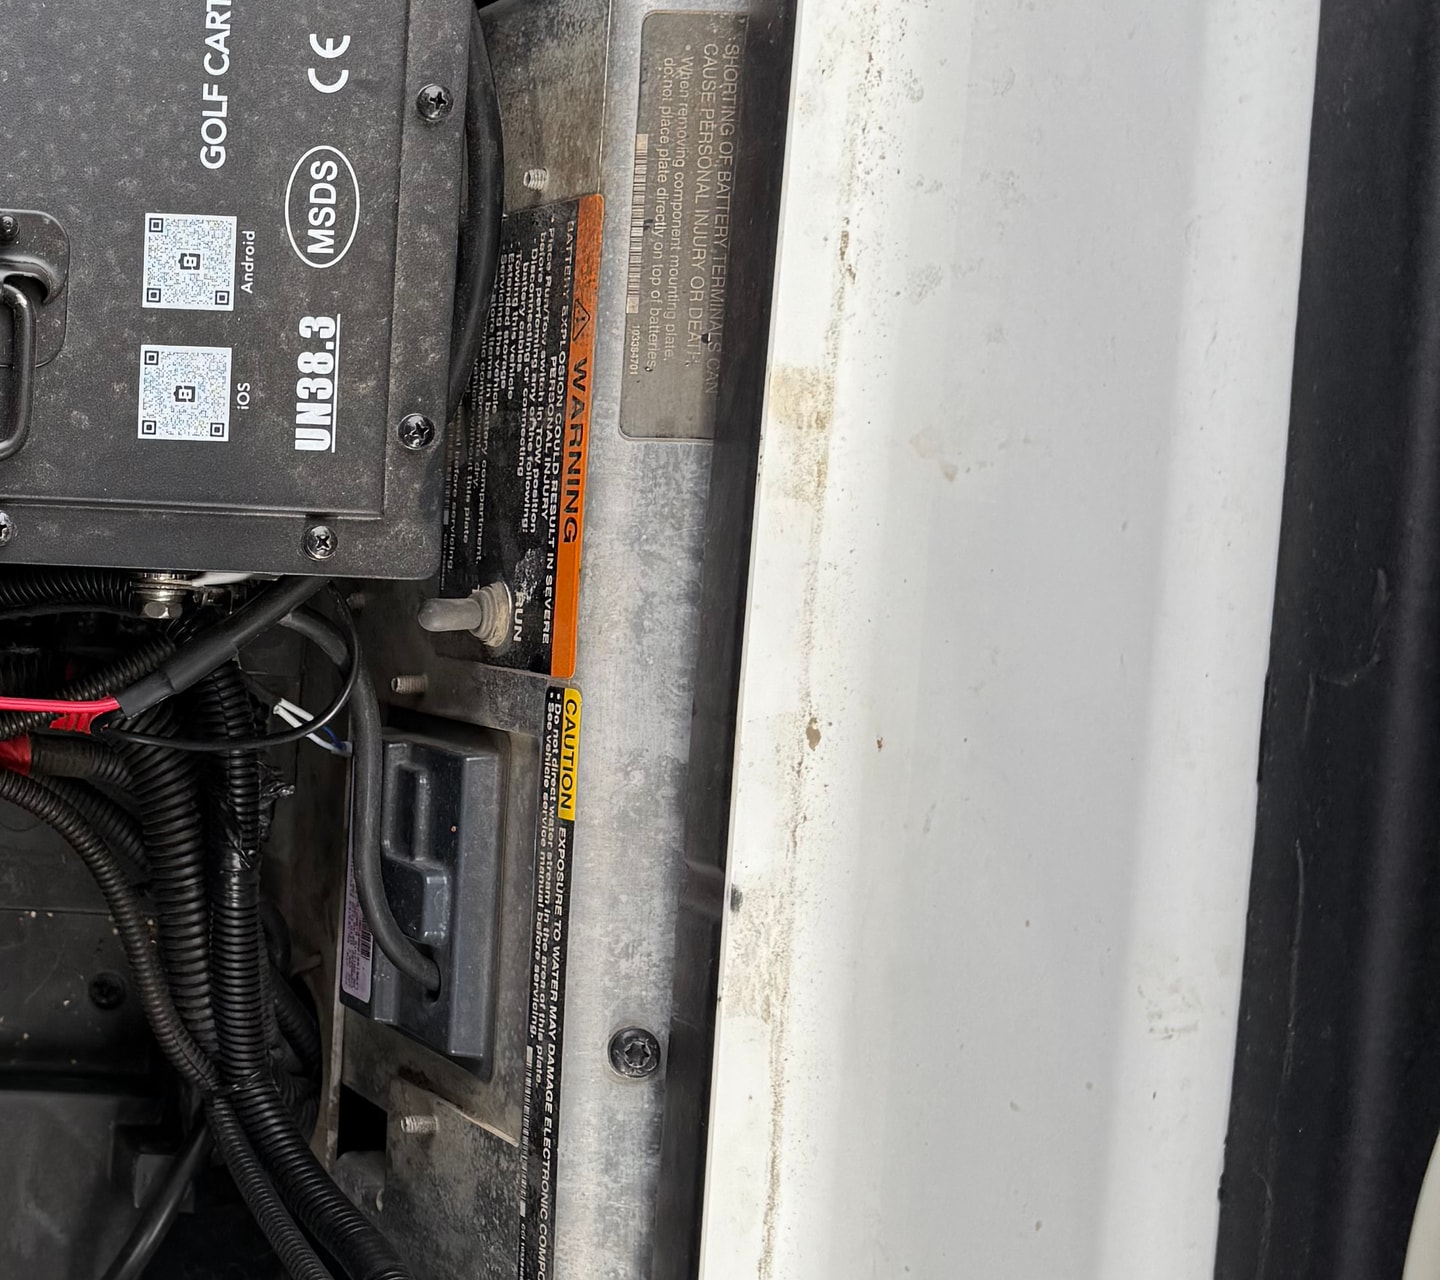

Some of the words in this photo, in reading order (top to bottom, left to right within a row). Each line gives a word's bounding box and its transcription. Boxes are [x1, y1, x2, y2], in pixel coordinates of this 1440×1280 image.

[307, 34, 350, 93] CE
[661, 79, 675, 101] not
[662, 57, 677, 76] do
[679, 56, 694, 99] When
[700, 42, 719, 104] CAUSE
[718, 43, 740, 137] SHORTING
[199, 83, 228, 169] GOLF
[656, 106, 674, 144] place
[672, 102, 692, 168] removing
[654, 148, 671, 183] plate
[694, 107, 715, 205] PERSONAL
[717, 140, 734, 167] OF
[307, 159, 339, 255] MSDS
[651, 187, 669, 237] directly
[667, 171, 688, 250] component
[712, 170, 733, 249] BATTERY
[240, 230, 256, 294] Android
[652, 241, 663, 260] on
[691, 208, 710, 272] INJURY
[649, 264, 665, 286] top
[650, 289, 663, 304] of
[663, 254, 684, 320] mounting
[689, 275, 706, 302] OR
[706, 254, 728, 353] TERMINALS
[556, 305, 570, 407] EXPLOSION
[704, 357, 722, 394] CAN
[237, 382, 250, 410] iOS
[295, 316, 336, 452] UN38.3
[545, 356, 558, 454] PERSONAL
[552, 412, 563, 475] COULD
[563, 357, 588, 543] WARNING
[541, 457, 552, 521] INJURY
[547, 480, 559, 548] RESULT
[546, 552, 555, 570] IN
[513, 591, 525, 642] RUN
[542, 574, 554, 644] SEVERE
[546, 702, 555, 731] See
[553, 703, 562, 725] Do
[543, 734, 553, 788] vehicle
[552, 728, 560, 754] not
[560, 698, 578, 810] CAUTION
[550, 757, 559, 801] direct
[540, 792, 550, 848] service
[547, 806, 556, 849] water
[537, 851, 547, 907] manual
[544, 851, 554, 904] stream
[554, 827, 567, 916] EXPOSURE
[534, 911, 544, 960] before
[542, 927, 550, 952] the
[543, 908, 551, 923] in
[553, 919, 563, 941] TO
[540, 955, 548, 989] area
[550, 944, 562, 1002] WATER
[529, 963, 541, 1038] servicing.
[537, 1013, 546, 1041] this
[539, 992, 547, 1010] of
[549, 1004, 559, 1040] MAY
[534, 1044, 545, 1088] plate.
[545, 1042, 557, 1114] DAMAGE
[540, 1116, 554, 1220] ELECTRONIC
